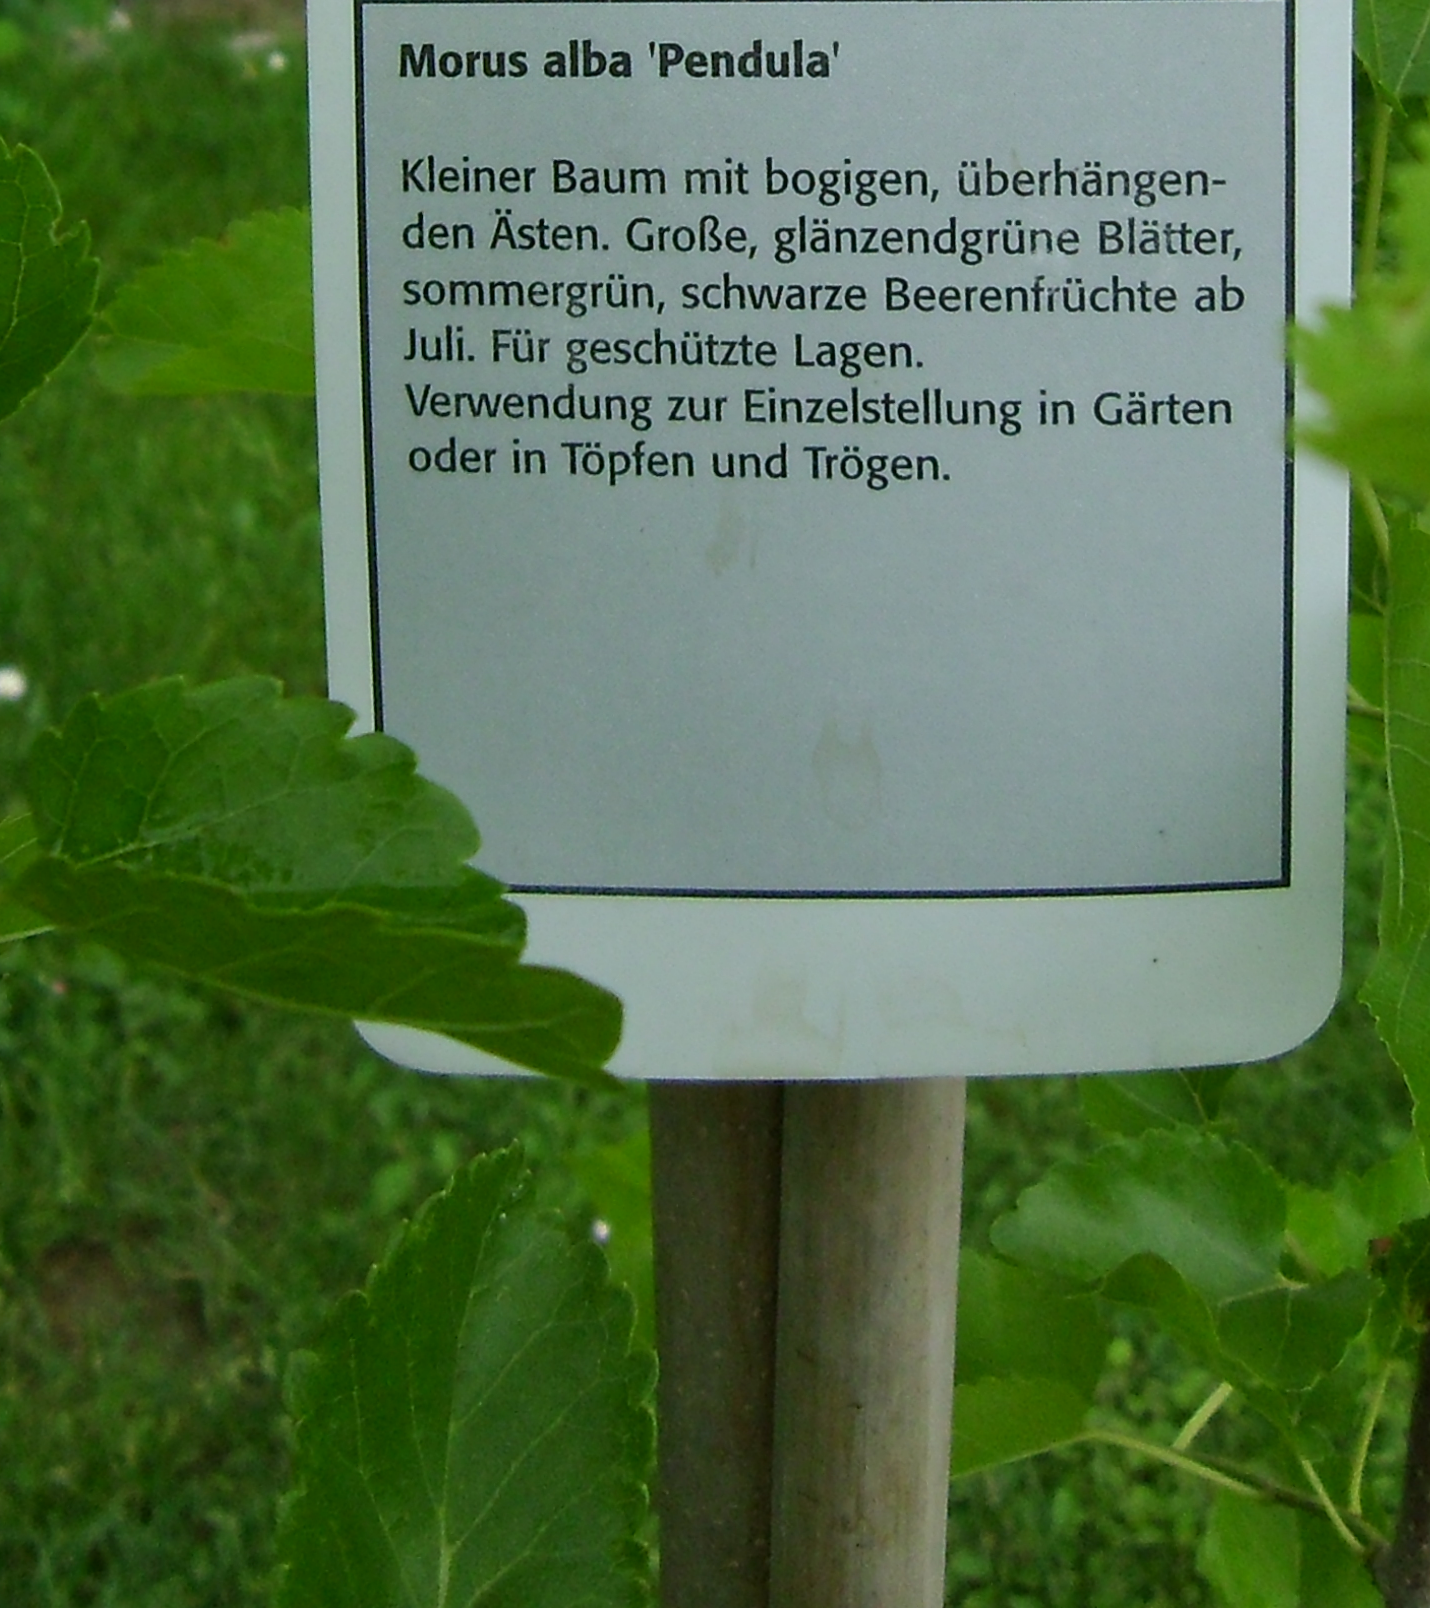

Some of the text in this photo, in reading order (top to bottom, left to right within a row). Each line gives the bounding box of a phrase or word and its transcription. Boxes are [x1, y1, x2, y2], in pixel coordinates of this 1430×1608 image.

[398, 38, 840, 79] Morus alba 'Pendula'
[401, 154, 1227, 209] Kleiner Baum mit bogigen, überhängen-
[401, 207, 1243, 267] den Ästen. Große, glänzendgrüne Blätter,
[402, 270, 1246, 320] sommergrün, schwarze Beerenfrüchte ab
[402, 323, 924, 378] Juli. Für geschützte Lagen.
[403, 381, 1233, 436] Verwendung zur Einzelstellung in Gärten
[408, 437, 951, 492] oder in Töpfen und Trögen.
